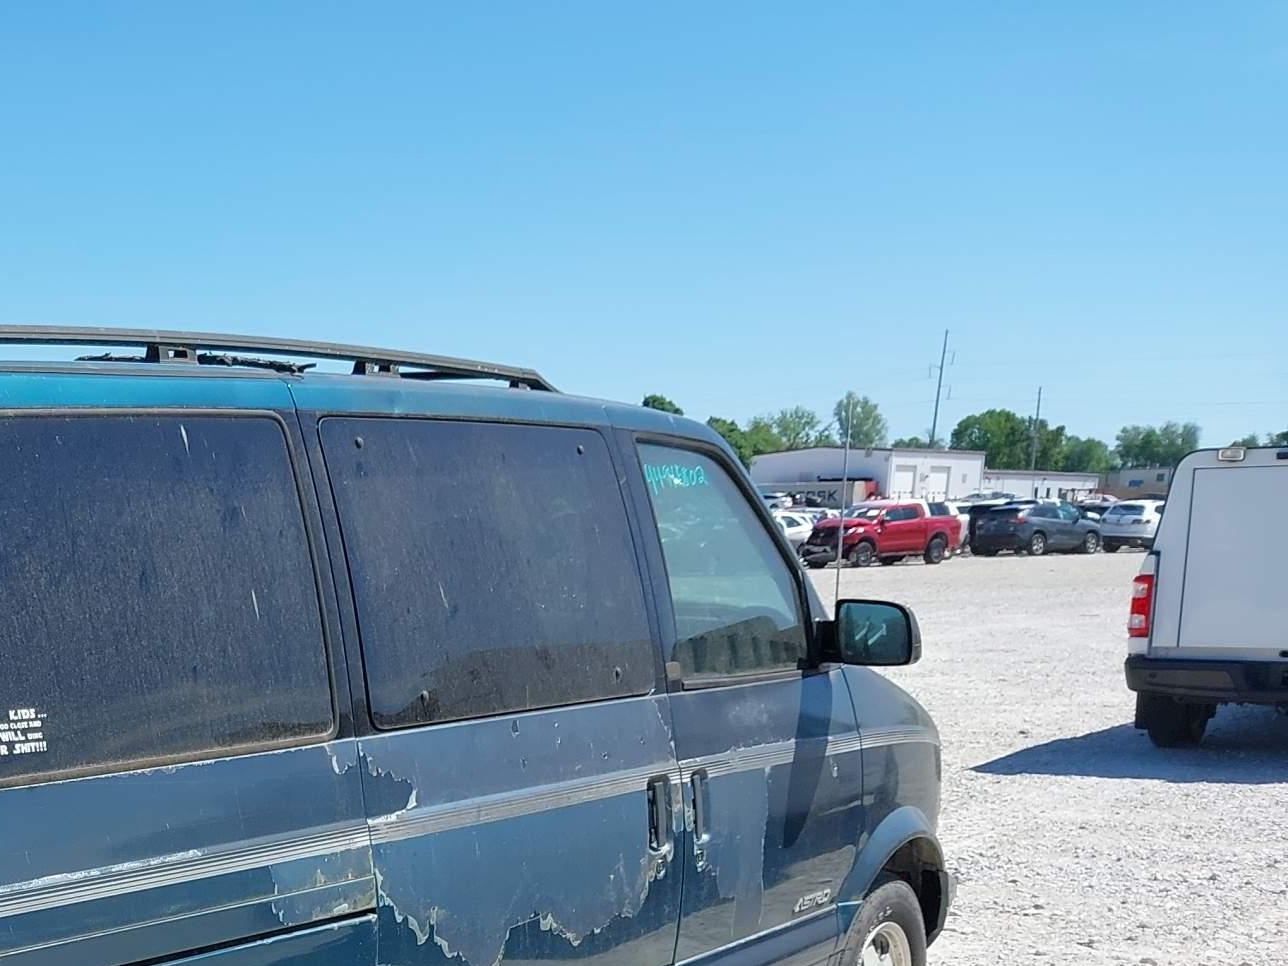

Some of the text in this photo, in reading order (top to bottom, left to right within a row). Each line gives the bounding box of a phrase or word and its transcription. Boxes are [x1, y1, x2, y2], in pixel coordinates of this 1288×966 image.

[9, 709, 35, 720] KIDS
[13, 740, 48, 755] SHIT!!!
[793, 888, 831, 913] ASTRO
